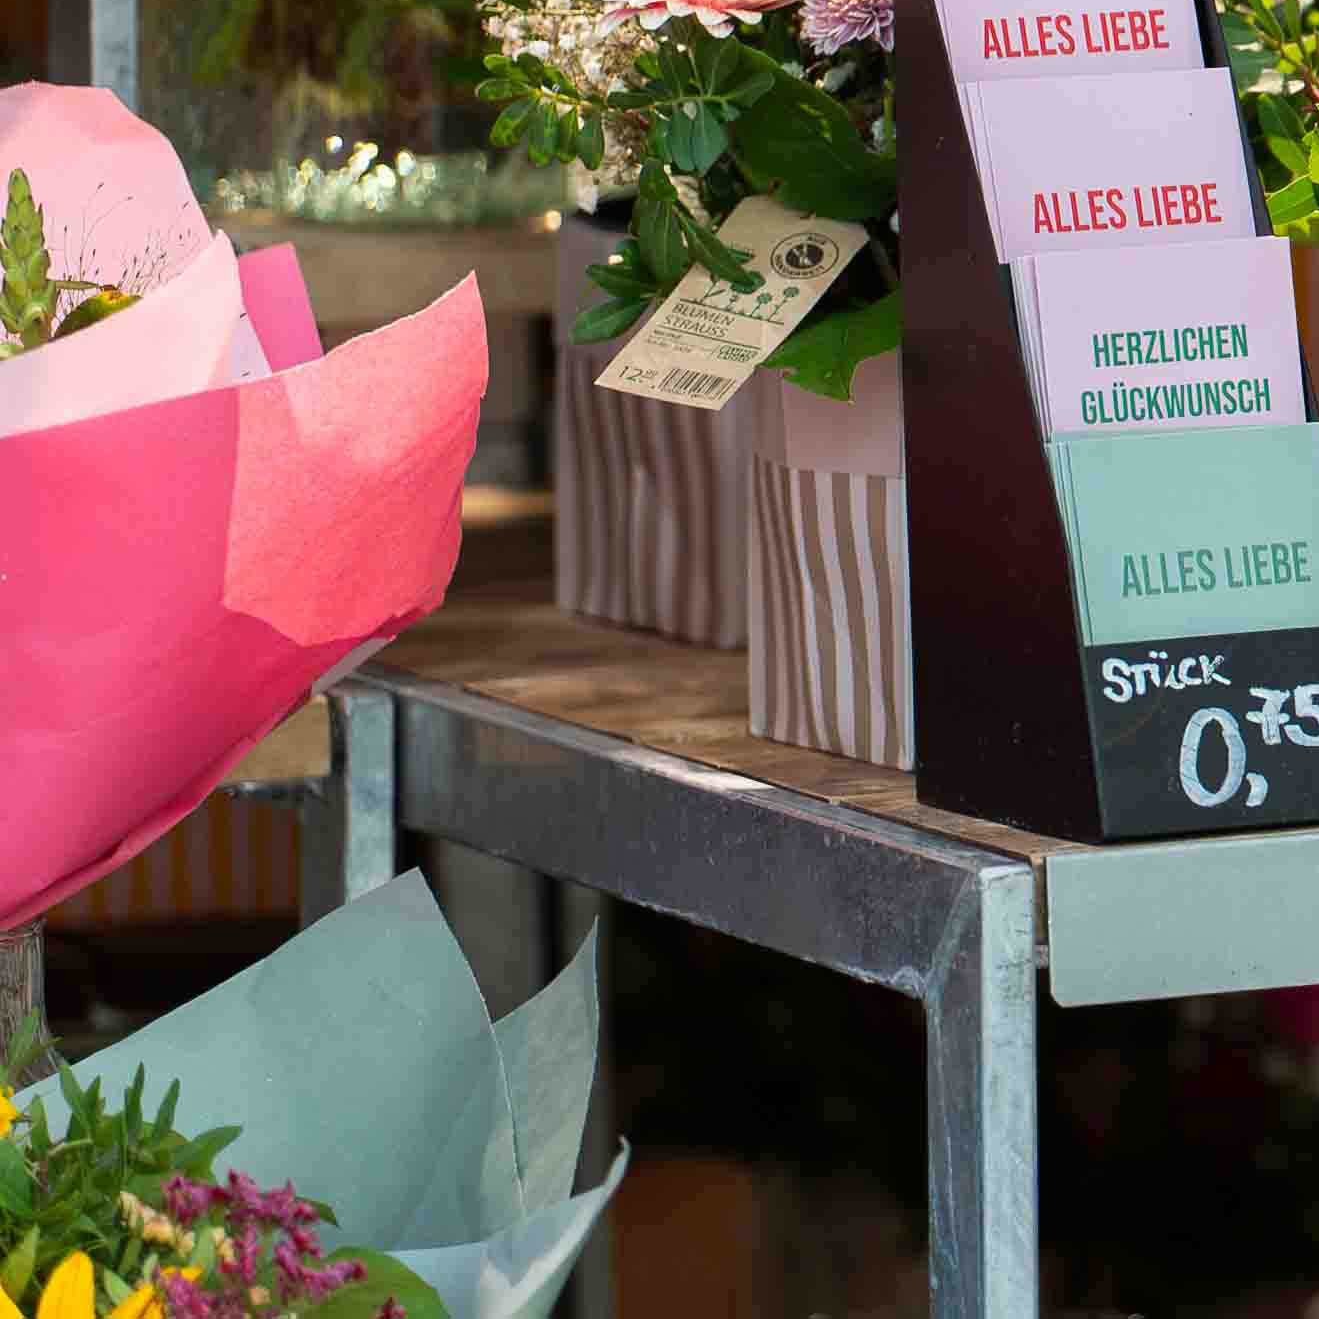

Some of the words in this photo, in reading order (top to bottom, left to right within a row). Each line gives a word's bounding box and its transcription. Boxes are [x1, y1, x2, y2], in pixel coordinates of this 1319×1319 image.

[983, 14, 1075, 59] ALLES
[1081, 8, 1169, 53] LIEBE
[1034, 188, 1127, 233] ALLES
[1133, 182, 1222, 228] LIEBE
[664, 314, 729, 338] STRAUSS
[671, 302, 736, 327] BLUMEN
[1092, 323, 1249, 368] HERZLICHEN
[1080, 377, 1272, 426] GLÜCKWUNSCH
[1121, 548, 1216, 598] ALLES
[1223, 541, 1312, 589] LIEBE
